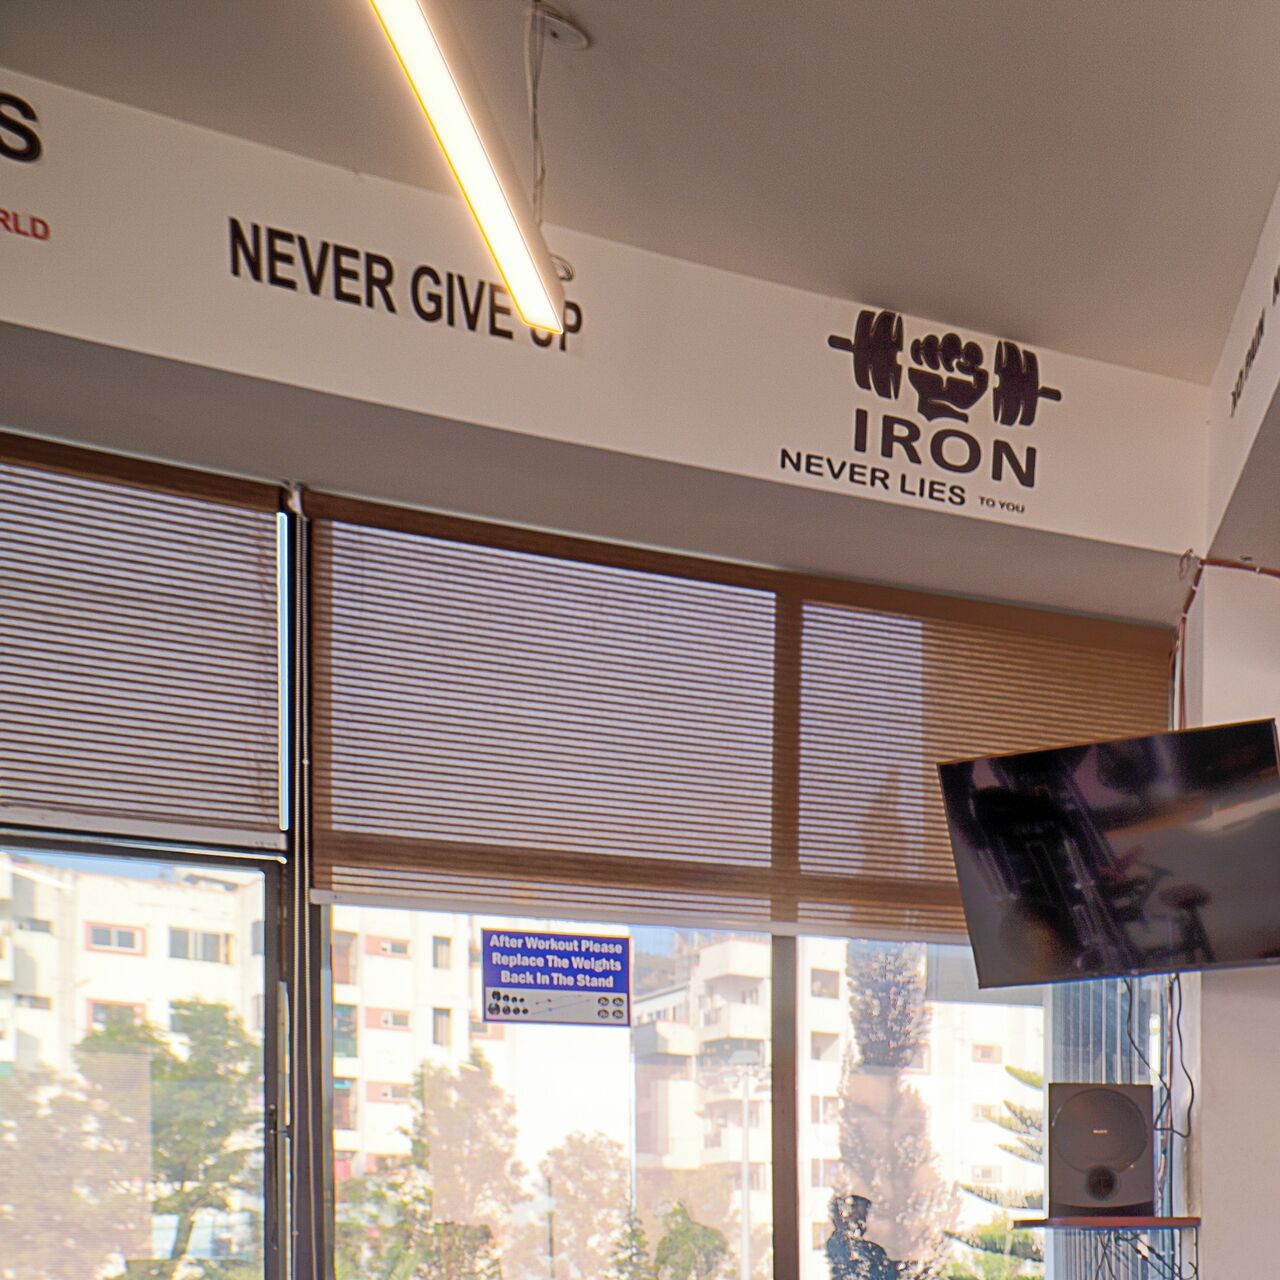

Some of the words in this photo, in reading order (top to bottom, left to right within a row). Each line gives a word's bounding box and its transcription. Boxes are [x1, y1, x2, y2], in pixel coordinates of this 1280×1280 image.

[228, 216, 397, 315] NEVER
[410, 263, 515, 341] GIVE
[853, 407, 1038, 489] IRON
[780, 447, 890, 491] NEVER
[899, 473, 967, 507] LIES
[978, 495, 996, 509] TO
[998, 498, 1026, 515] YOU
[490, 934, 523, 949] After
[524, 936, 580, 953] Workout
[580, 939, 624, 955] Please
[491, 952, 546, 969] Replace
[545, 954, 570, 969] The
[570, 956, 622, 973] Weights
[500, 970, 535, 986] Back
[535, 971, 550, 986] In
[550, 972, 575, 987] The
[576, 974, 614, 989] Stand
